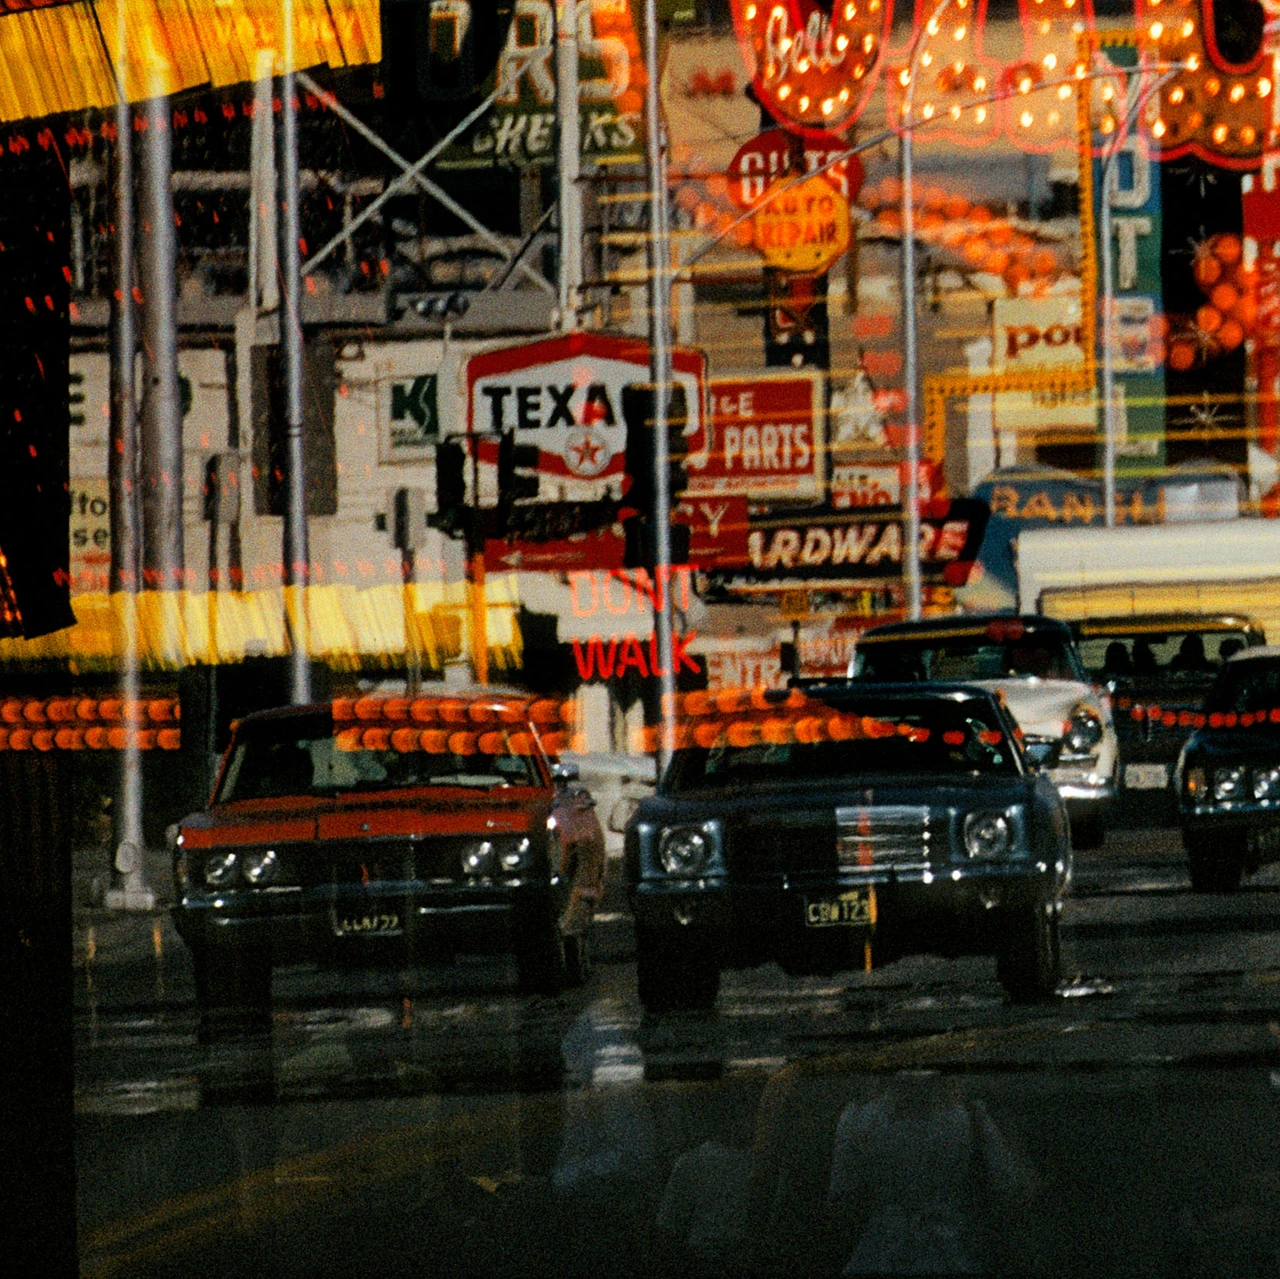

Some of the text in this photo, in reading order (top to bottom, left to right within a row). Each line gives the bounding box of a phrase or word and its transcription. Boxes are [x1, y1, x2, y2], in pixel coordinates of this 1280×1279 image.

[472, 111, 643, 155] CHEKS
[739, 150, 850, 206] GITS
[482, 383, 615, 429] TEXA
[725, 423, 811, 470] PARTS
[748, 520, 969, 569] ARDWARE
[571, 629, 701, 680] WALK
